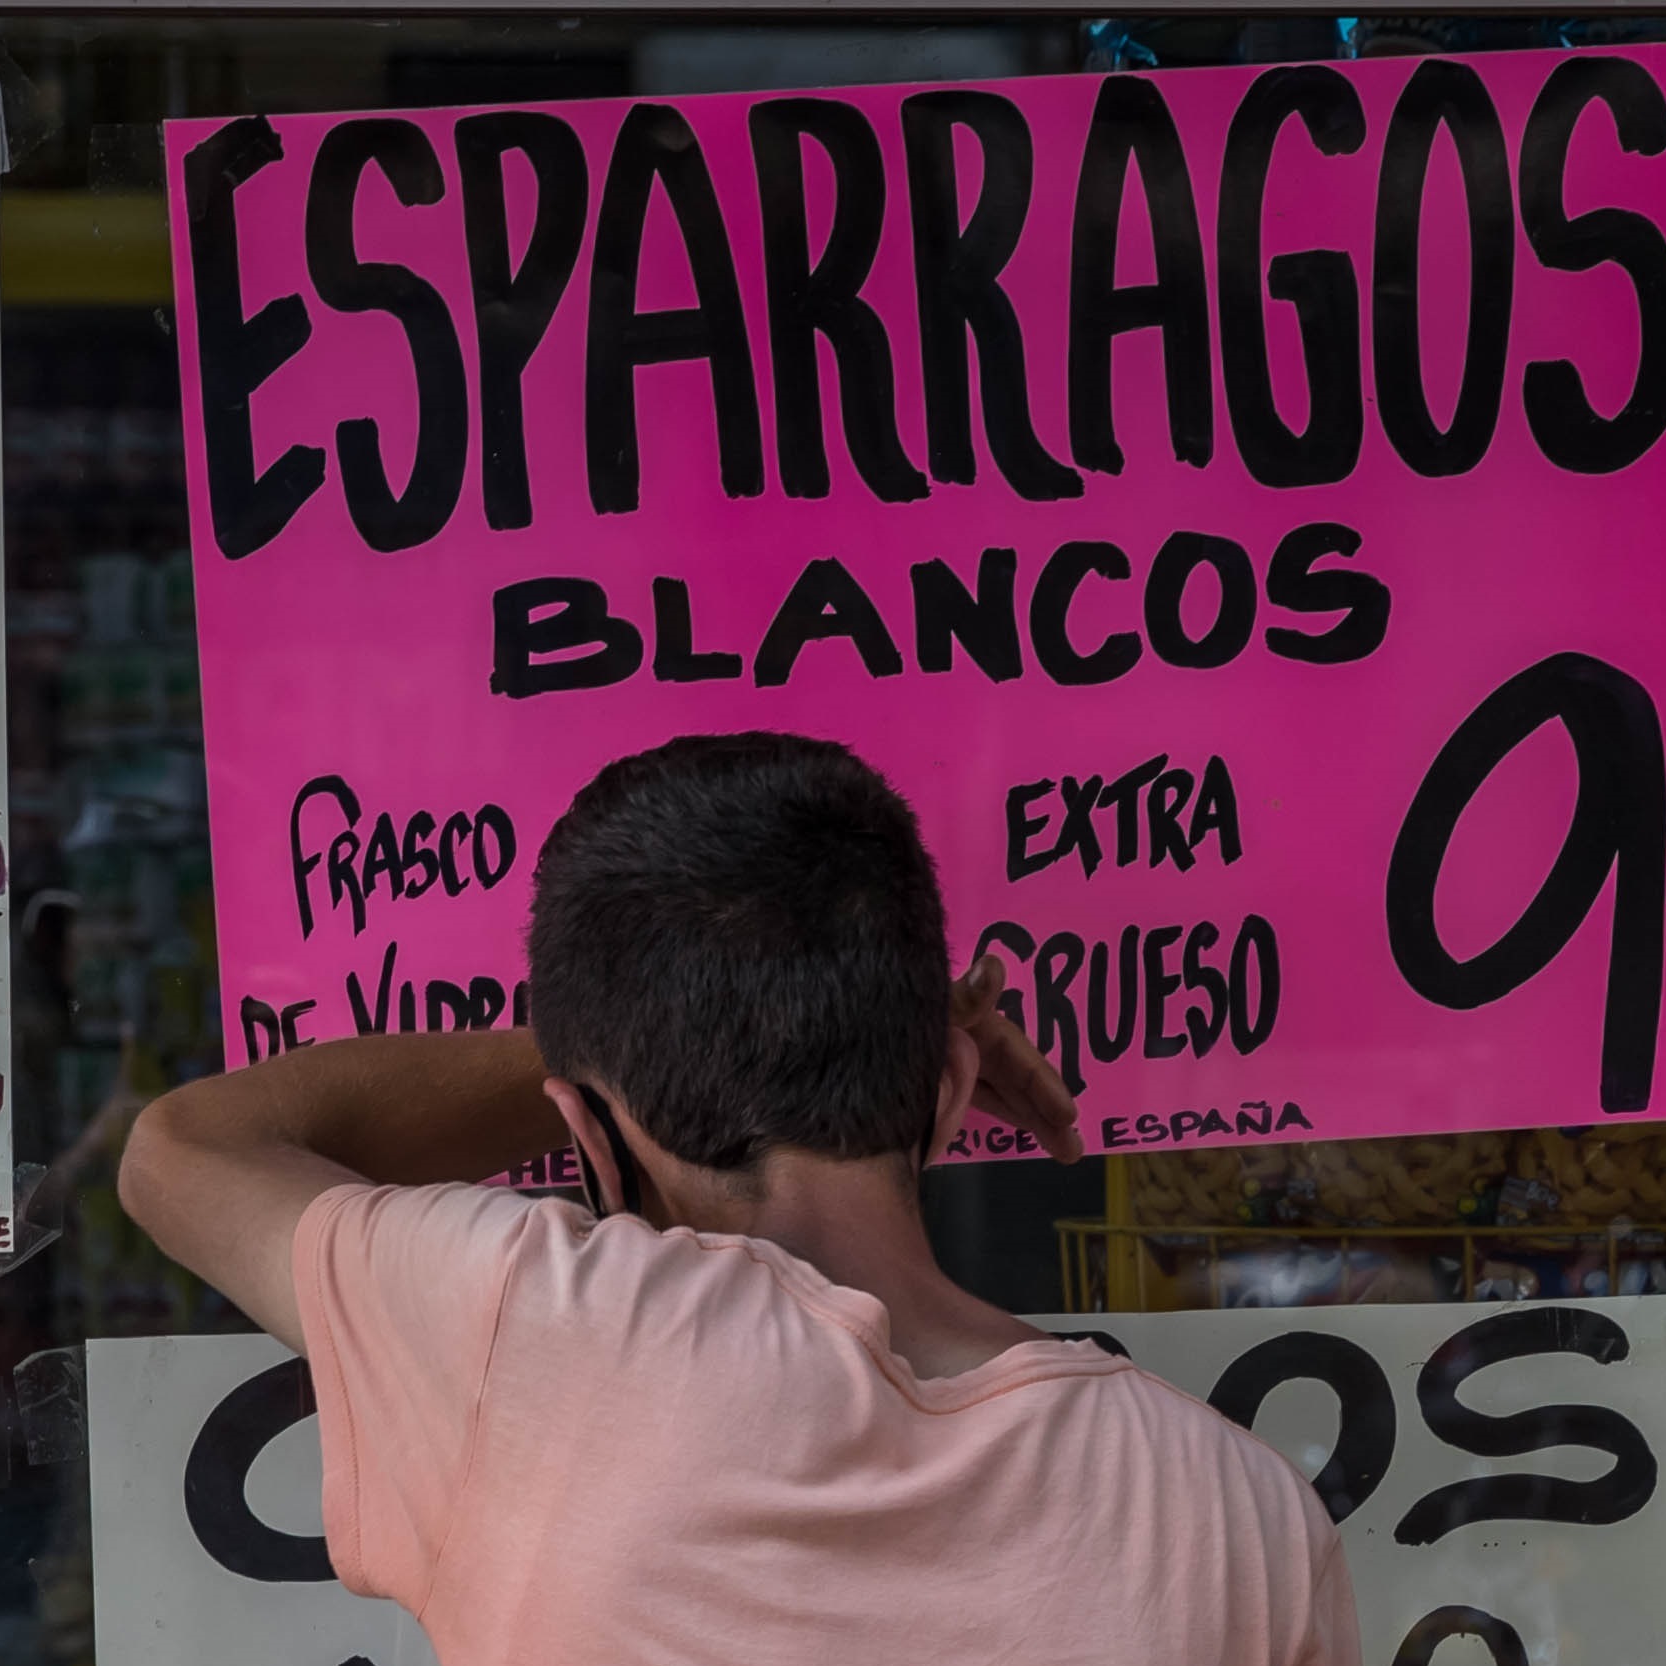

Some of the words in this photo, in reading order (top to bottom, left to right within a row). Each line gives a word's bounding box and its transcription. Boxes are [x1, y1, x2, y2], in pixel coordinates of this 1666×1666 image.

[490, 522, 1391, 698] BLANCOS
[290, 775, 516, 941] FRASCO
[1006, 753, 1243, 883] EXTRA
[947, 1125, 1048, 1157] RIGE
[1101, 1101, 1314, 1149] ESPAÑA
